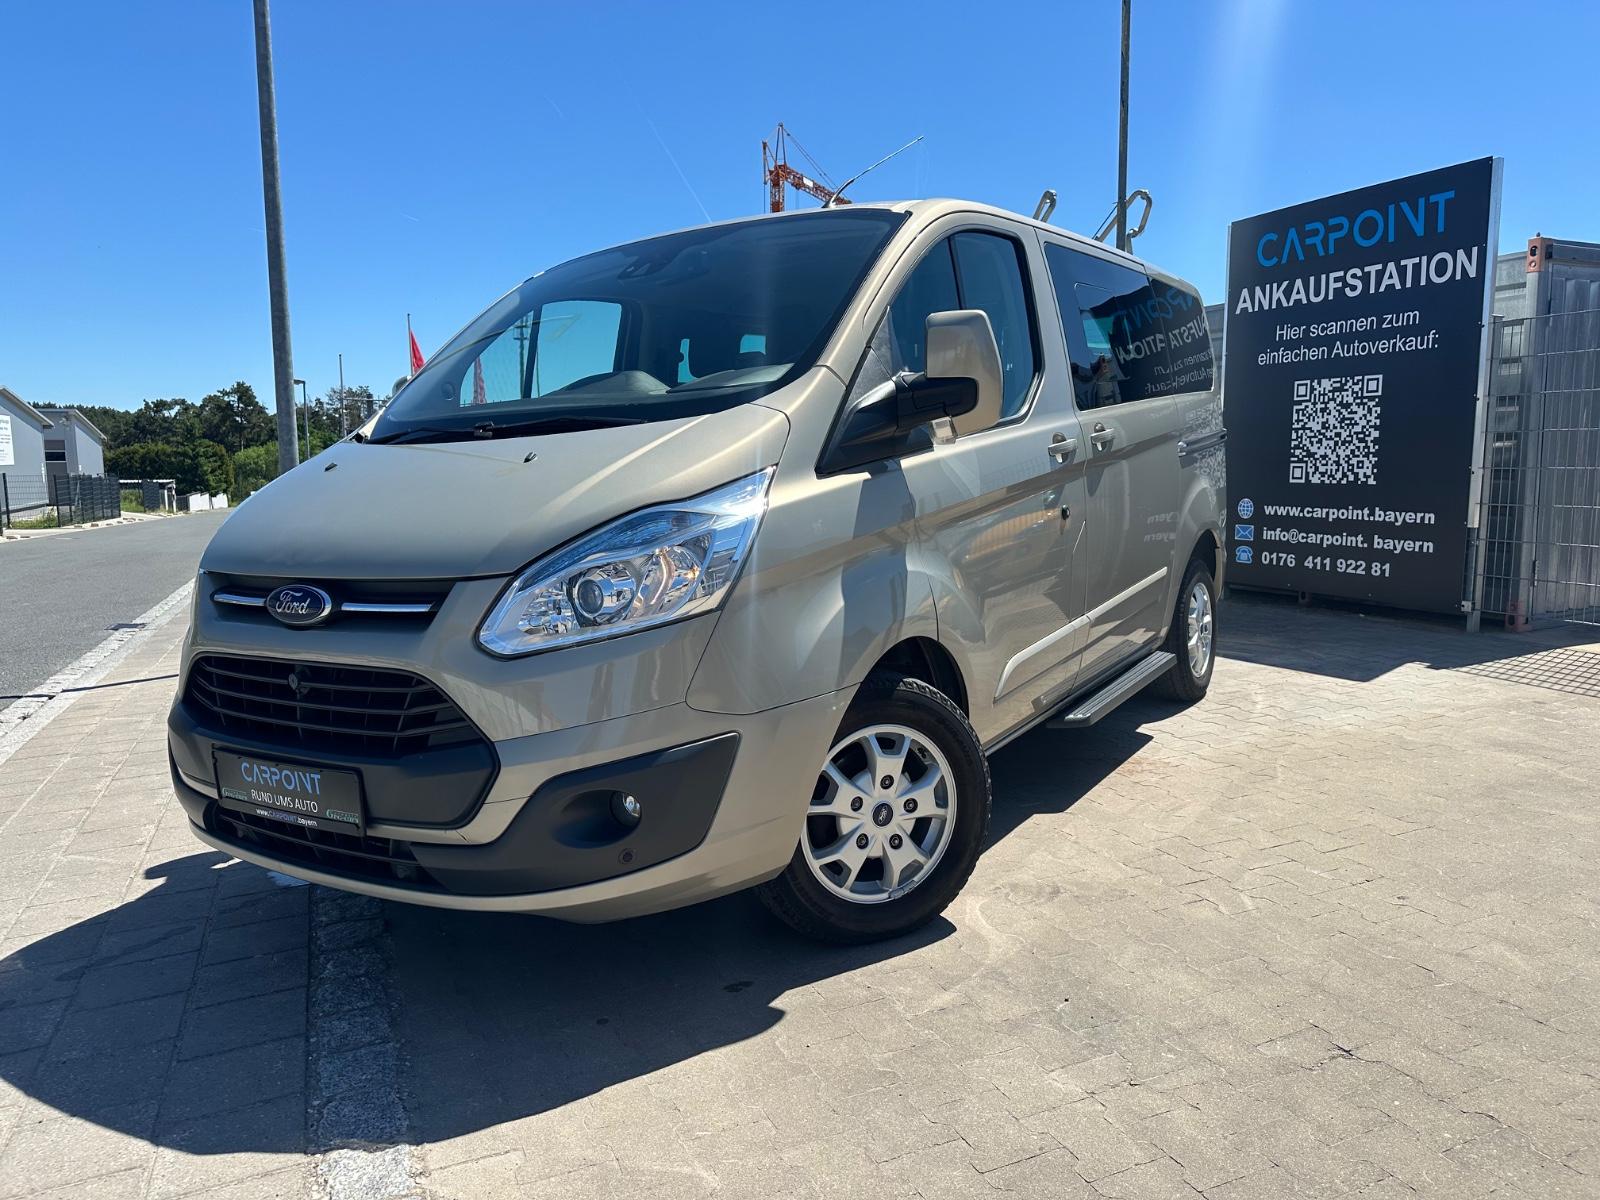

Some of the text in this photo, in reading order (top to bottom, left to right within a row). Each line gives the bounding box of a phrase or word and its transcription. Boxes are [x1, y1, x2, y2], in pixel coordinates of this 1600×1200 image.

[1256, 190, 1456, 267] CARPOINT
[1235, 246, 1479, 314] ANKAUFSTATION
[1276, 310, 1420, 342] Hier scannen zum
[1257, 329, 1439, 365] einfachen Autoverkauf:
[1264, 503, 1436, 526] www.carpoint.bayern
[1262, 527, 1434, 554] info@carpoint. bayern
[1261, 551, 1391, 577] 0176 411 922 81
[275, 590, 311, 614] Ford
[241, 761, 321, 795] CARPOINT
[251, 788, 273, 804] RUND
[274, 795, 293, 809] UMS
[295, 798, 318, 813] AUTO
